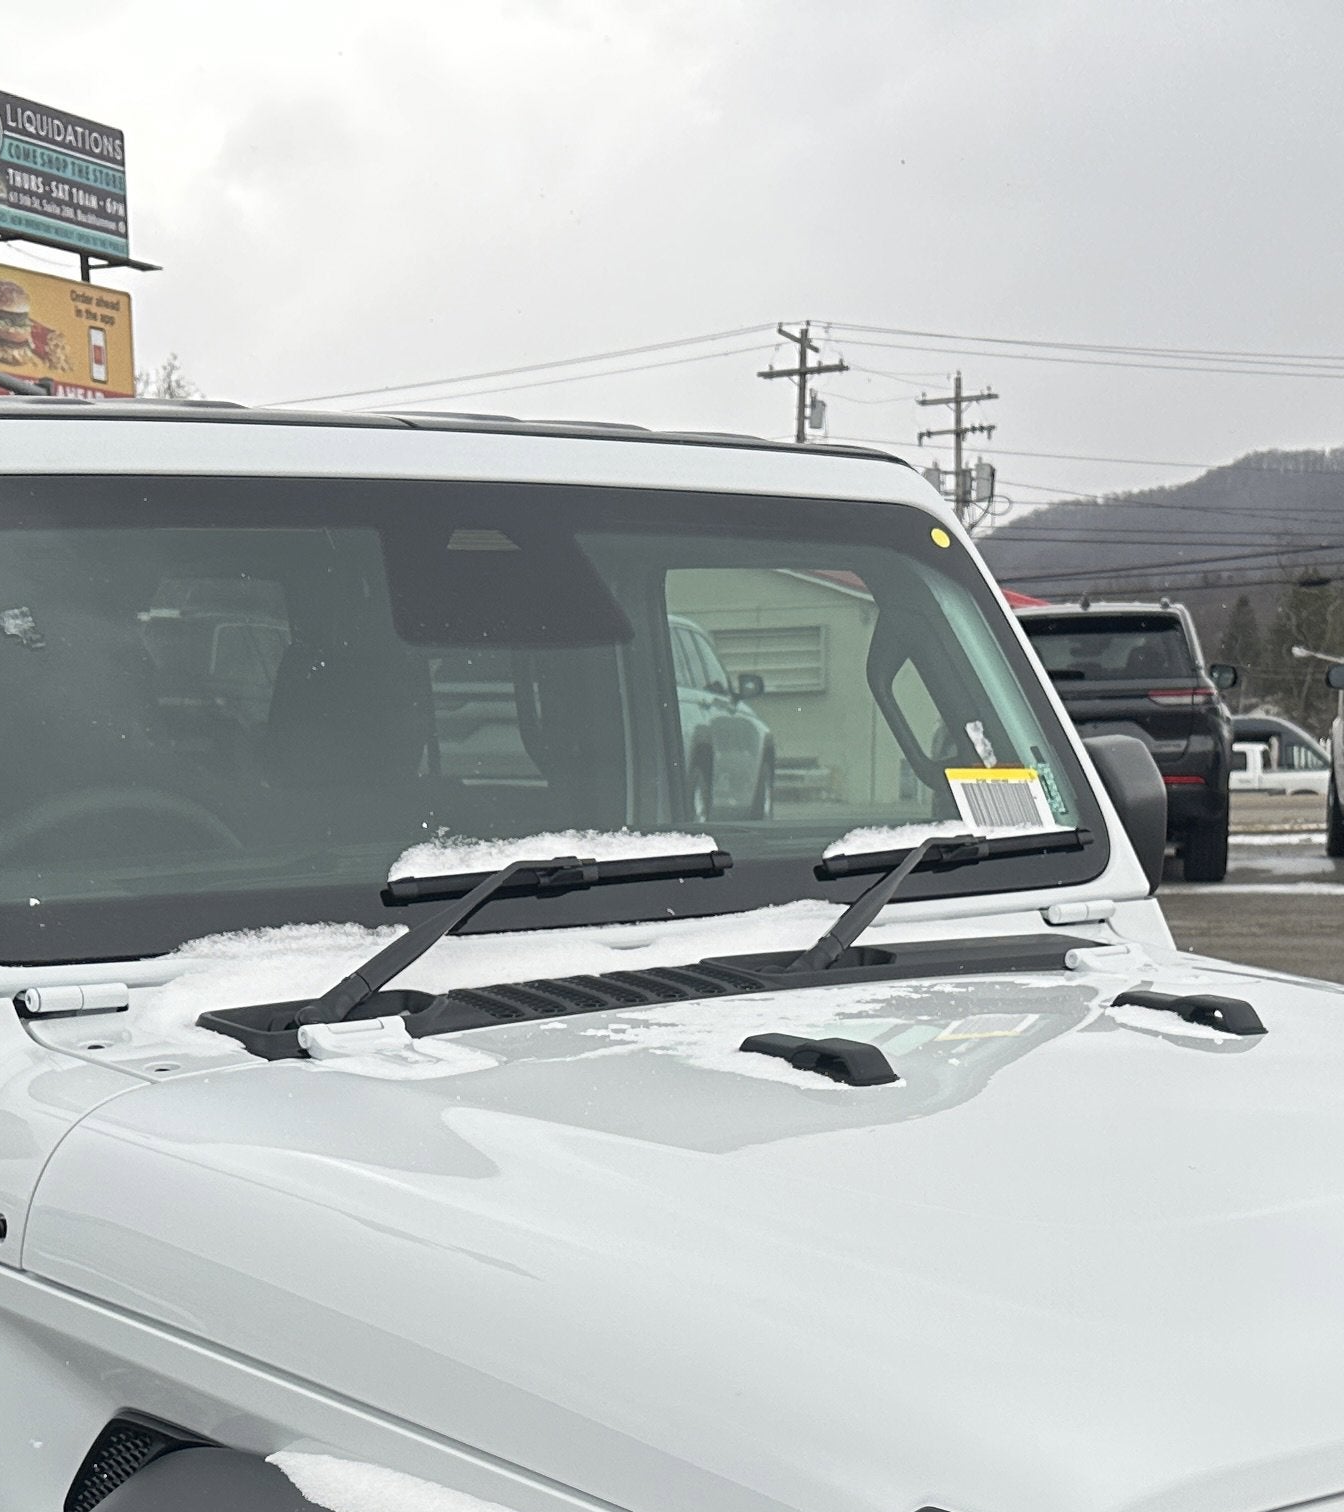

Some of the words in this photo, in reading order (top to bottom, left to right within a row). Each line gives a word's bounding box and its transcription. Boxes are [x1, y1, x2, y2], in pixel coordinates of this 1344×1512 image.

[6, 104, 122, 160] LIQUIDATIONS
[8, 142, 38, 165] COME
[40, 151, 68, 173] SHOP
[71, 161, 91, 182] THE
[7, 168, 44, 193] THURS
[50, 181, 70, 201] SAT
[71, 187, 98, 210] 10AM
[70, 289, 93, 306] Order
[95, 295, 121, 312] ahead
[74, 305, 84, 318] in
[84, 307, 98, 322] the
[99, 313, 116, 327] app
